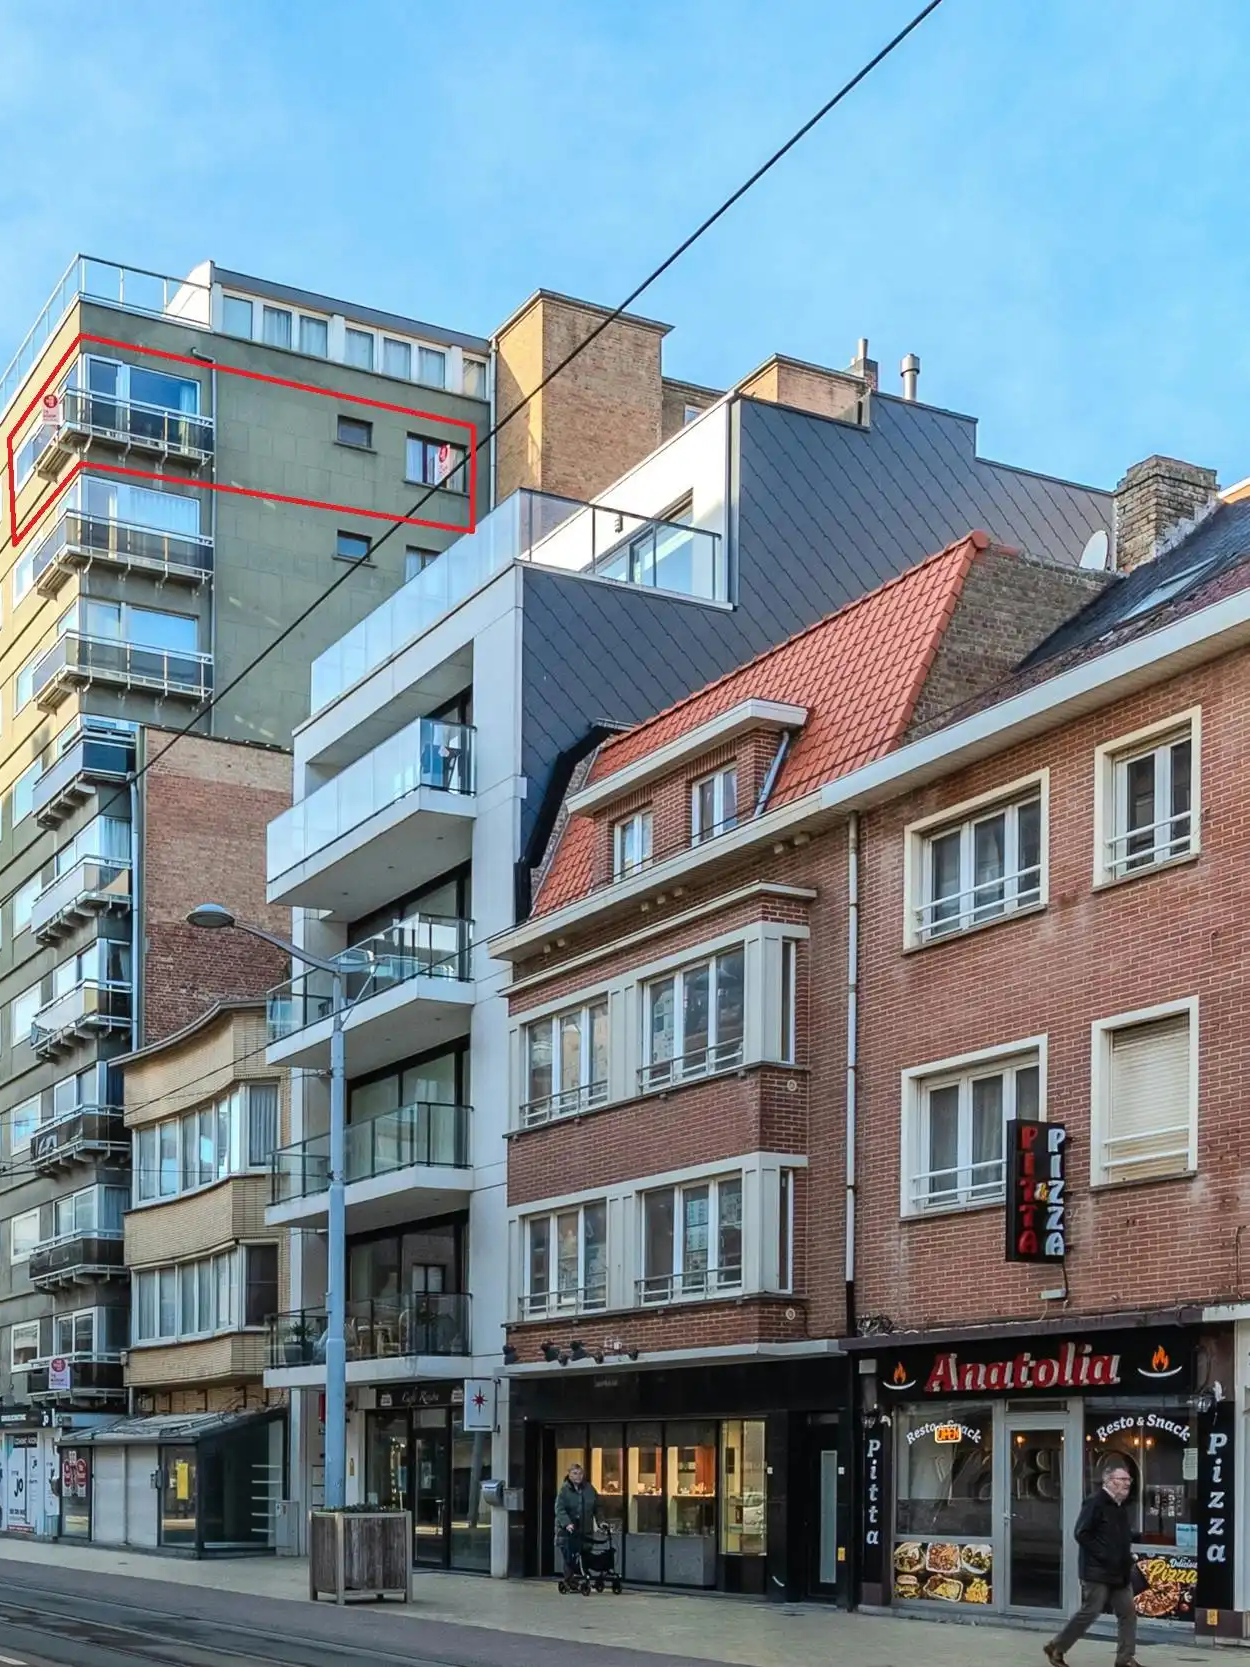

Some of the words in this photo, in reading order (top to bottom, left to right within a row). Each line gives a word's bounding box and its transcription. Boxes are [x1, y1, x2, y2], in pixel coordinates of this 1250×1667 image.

[1018, 1127, 1038, 1254] PITTA
[1045, 1128, 1066, 1256] PIZZA
[925, 1341, 1121, 1393] Anatolia
[906, 1422, 936, 1445] Resto
[1096, 1416, 1134, 1441] Resto
[1136, 1416, 1145, 1426] &
[1146, 1413, 1191, 1442] Snack
[866, 1439, 881, 1545] Pitta
[1206, 1433, 1228, 1563] Pizza
[1148, 1559, 1198, 1586] Pizza
